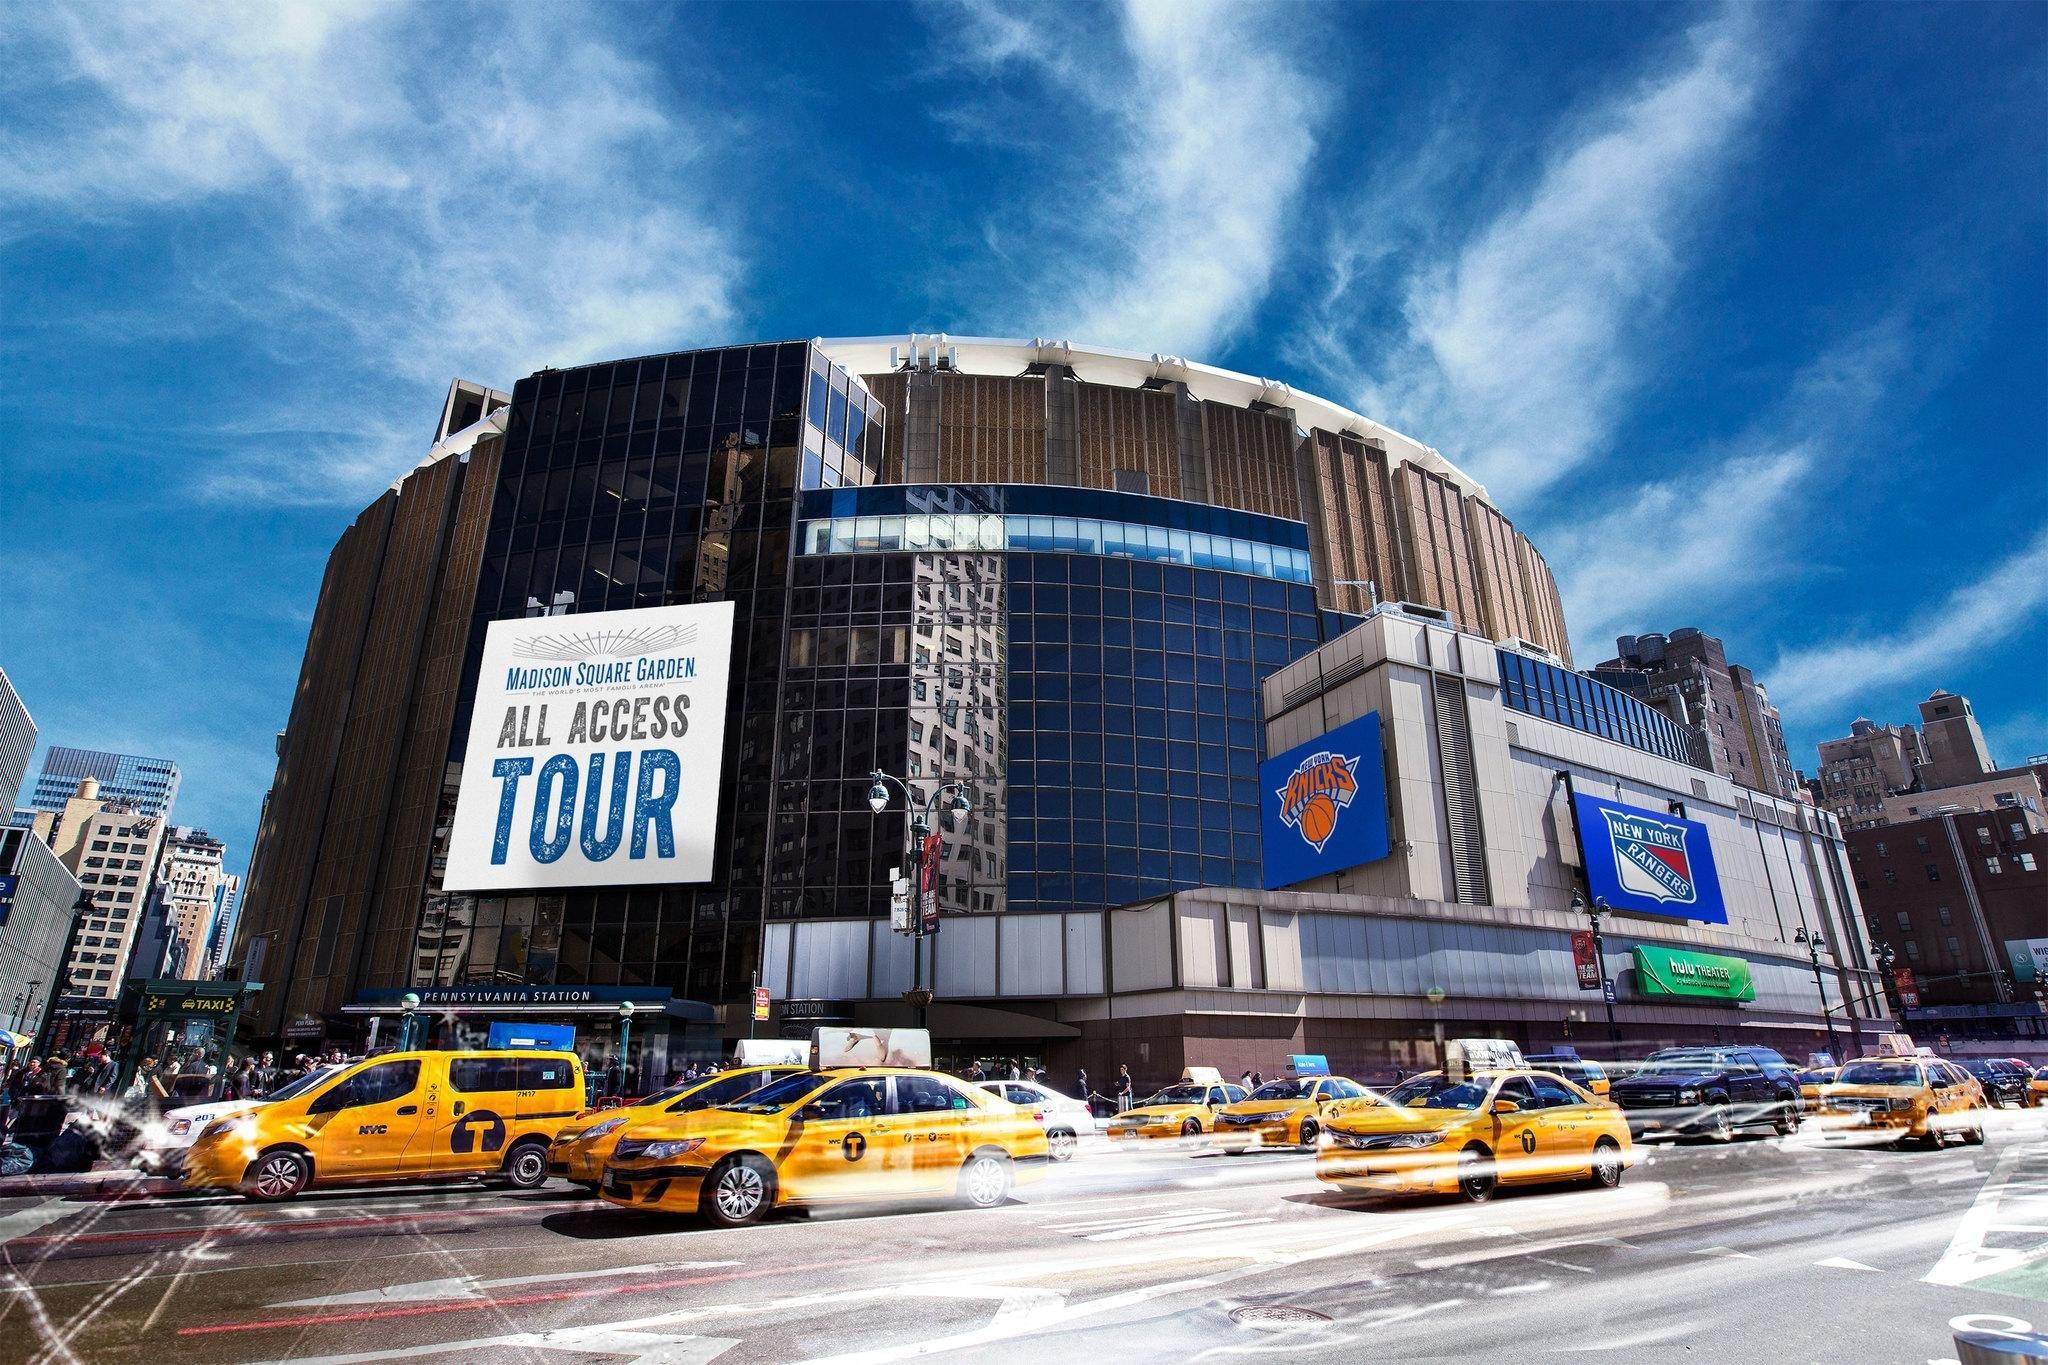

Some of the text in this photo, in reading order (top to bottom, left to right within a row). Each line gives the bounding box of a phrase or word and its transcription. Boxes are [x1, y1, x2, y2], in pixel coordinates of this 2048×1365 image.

[506, 667, 572, 690] MADISON
[576, 662, 632, 686] SQUARE
[549, 688, 580, 696] WORLD'S
[606, 684, 637, 692] FAMOUS
[497, 694, 691, 749] ALL ACCESS
[1314, 753, 1330, 765] YORK
[1282, 757, 1355, 817] KNICKS
[490, 749, 681, 865] TOUR
[1612, 821, 1681, 848] NEW YORK
[1627, 842, 1689, 896] RANGERS
[1579, 971, 1597, 979] TEAM
[1669, 957, 1730, 978] hulu THEATER
[424, 991, 590, 1001] PENNSYLVANIA STATION
[196, 1000, 225, 1010] TAXI
[790, 1003, 824, 1015] STATION
[359, 1125, 387, 1135] NYC
